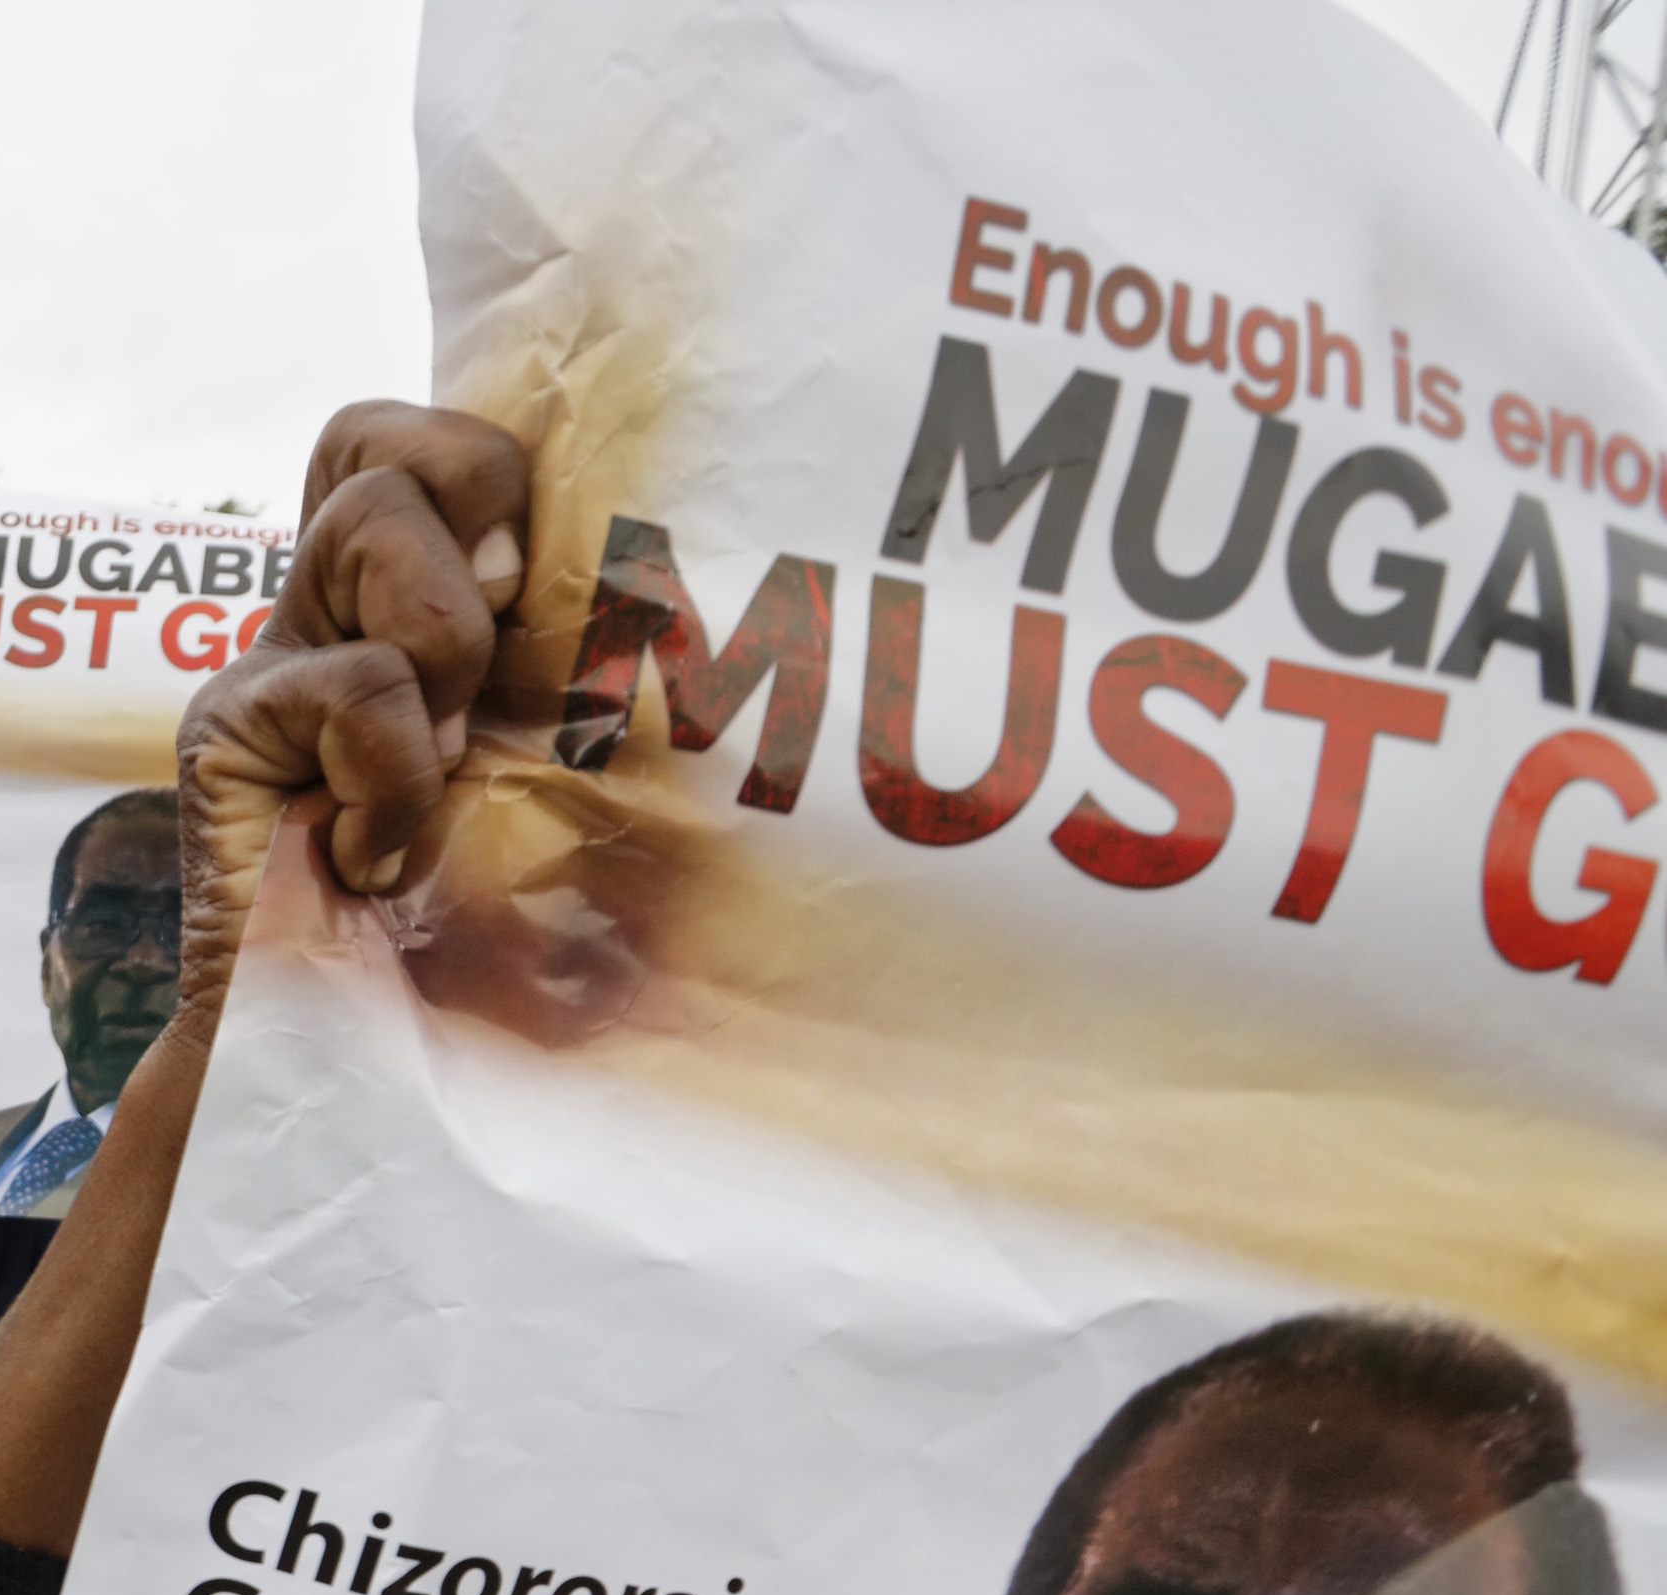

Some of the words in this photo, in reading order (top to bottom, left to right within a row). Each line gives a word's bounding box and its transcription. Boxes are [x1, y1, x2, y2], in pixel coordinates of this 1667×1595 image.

[949, 196, 1363, 415] Enough
[1392, 329, 1466, 442] is
[1490, 390, 1667, 521] eno
[112, 513, 142, 534] is
[550, 514, 1448, 925] MUST
[1481, 728, 1667, 988] G
